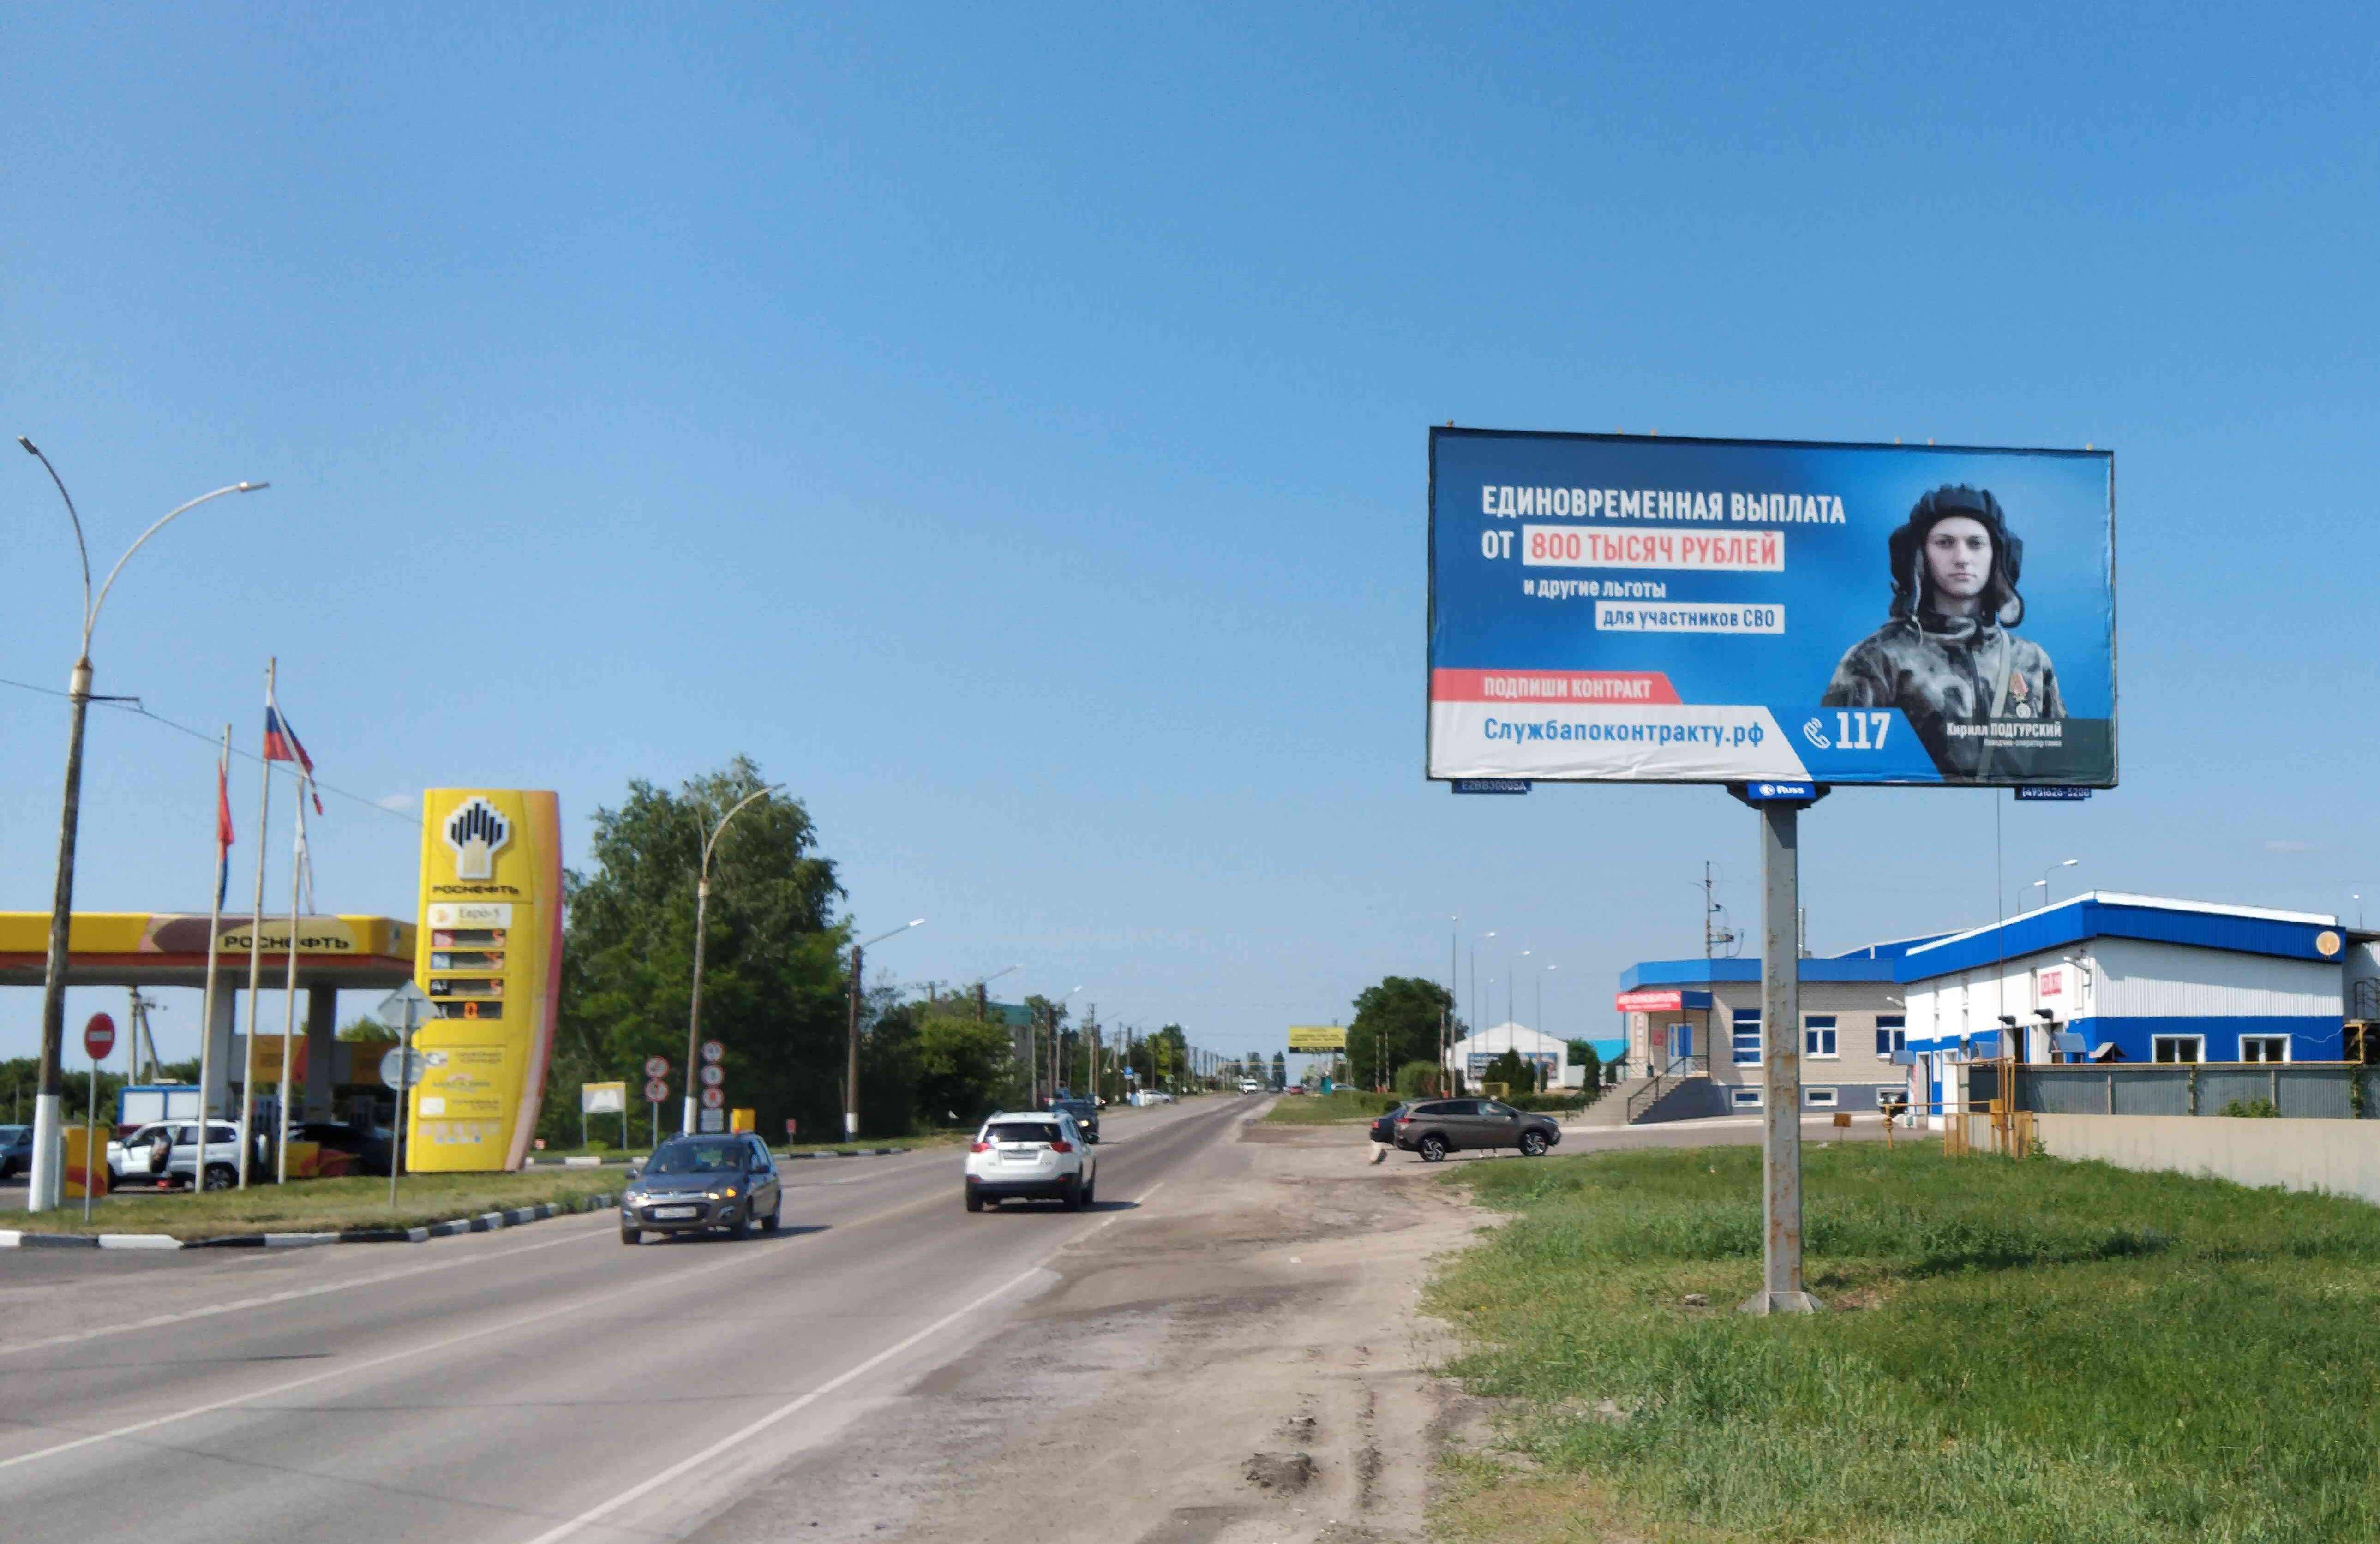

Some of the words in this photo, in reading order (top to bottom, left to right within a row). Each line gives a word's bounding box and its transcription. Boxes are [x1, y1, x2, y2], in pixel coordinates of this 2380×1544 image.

[1482, 486, 1723, 521] ЕДИНОВРЕМЕННАЯ
[1731, 493, 1846, 524] ВЫПЛАТА
[1482, 531, 1514, 559] ОТ
[1531, 533, 1580, 560] 800
[1588, 533, 1672, 563] ТЫСЯЧ
[1682, 531, 1776, 565] РУБЛЕЙ
[1523, 580, 1535, 595] и
[1538, 580, 1599, 600] другие
[1603, 581, 1666, 598] льготы
[1603, 610, 1634, 627] для
[1640, 611, 1739, 630] участников
[1744, 610, 1775, 628] СВО
[1484, 677, 1568, 699] ПОДПИШИ
[1572, 679, 1653, 700] КОНТРАКТ
[1485, 718, 1764, 747] Службапоконтракту.рф
[1836, 712, 1891, 750] 117
[1946, 722, 1989, 738] Кирилл
[1990, 721, 2062, 738] ПОДГУРСКИЙ
